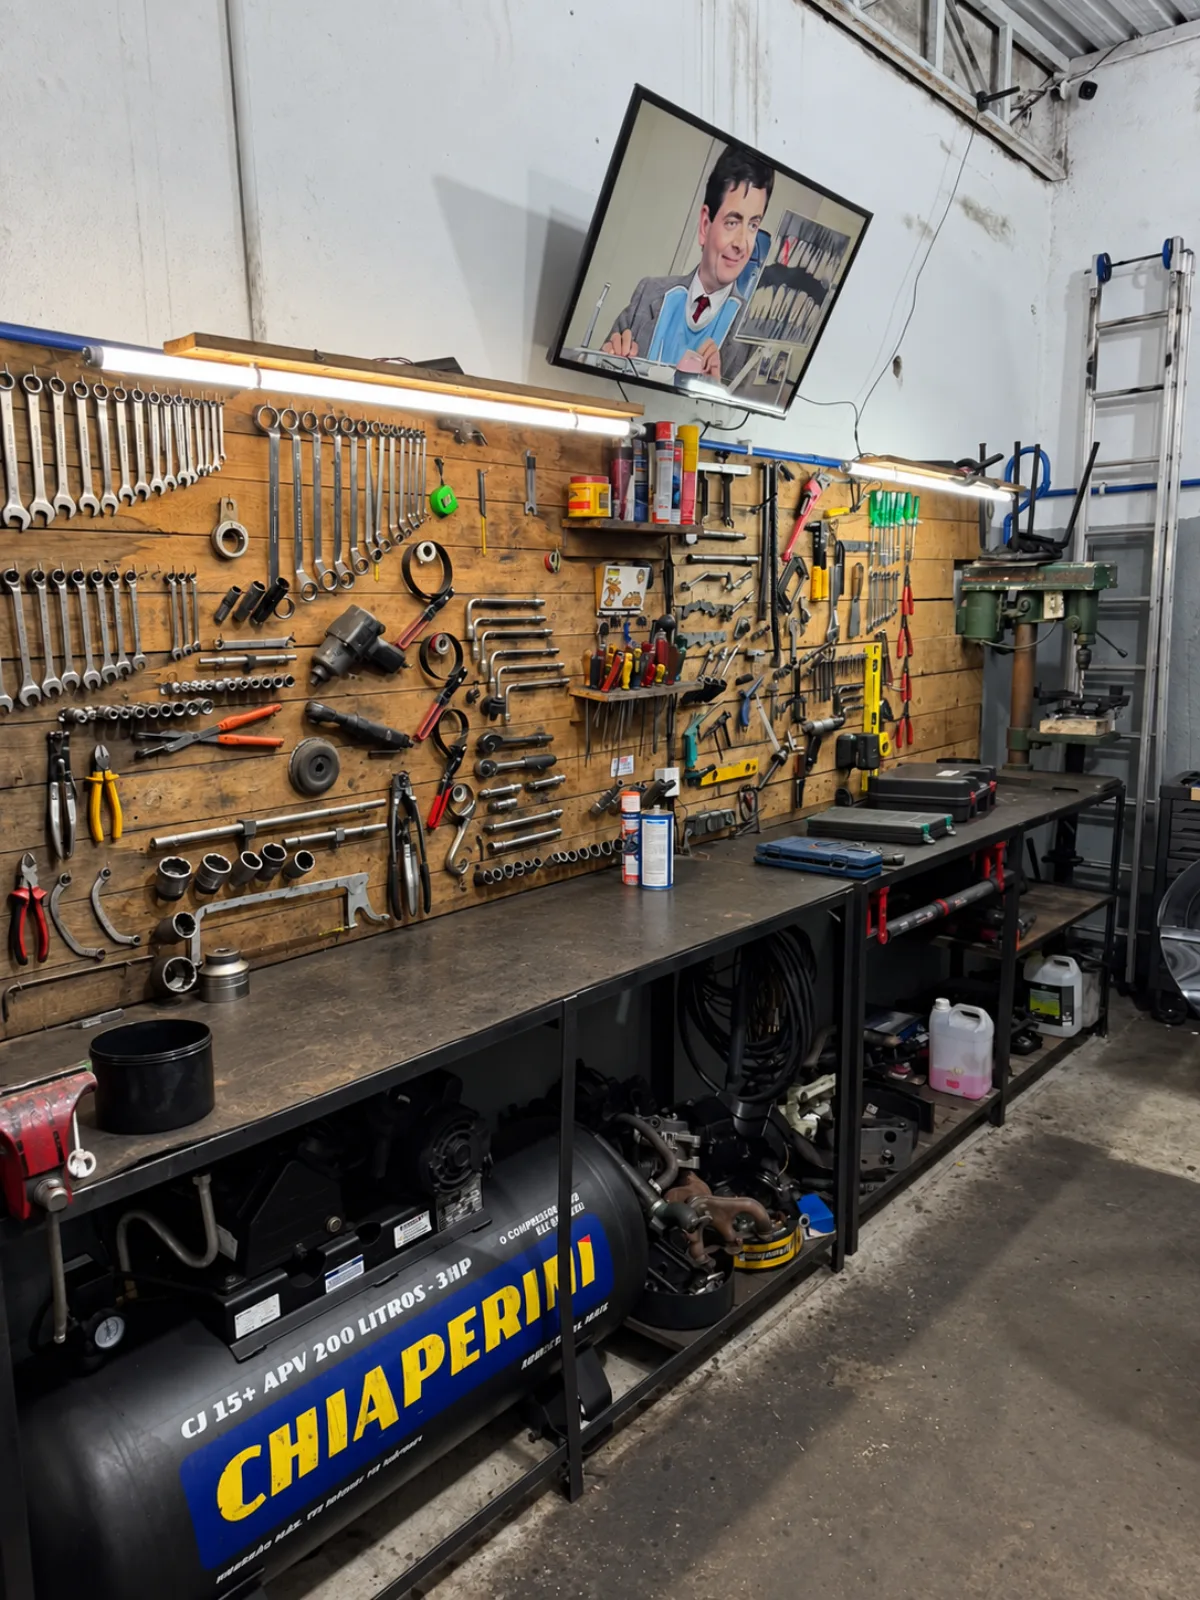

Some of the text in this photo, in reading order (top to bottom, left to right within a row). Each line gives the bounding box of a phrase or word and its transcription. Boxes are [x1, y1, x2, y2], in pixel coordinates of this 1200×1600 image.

[181, 1410, 208, 1439] CJ
[212, 1386, 256, 1422] 15+
[263, 1351, 307, 1394] APV
[312, 1329, 355, 1362] 200
[358, 1284, 427, 1336] LITROS
[435, 1257, 472, 1289] 3HP
